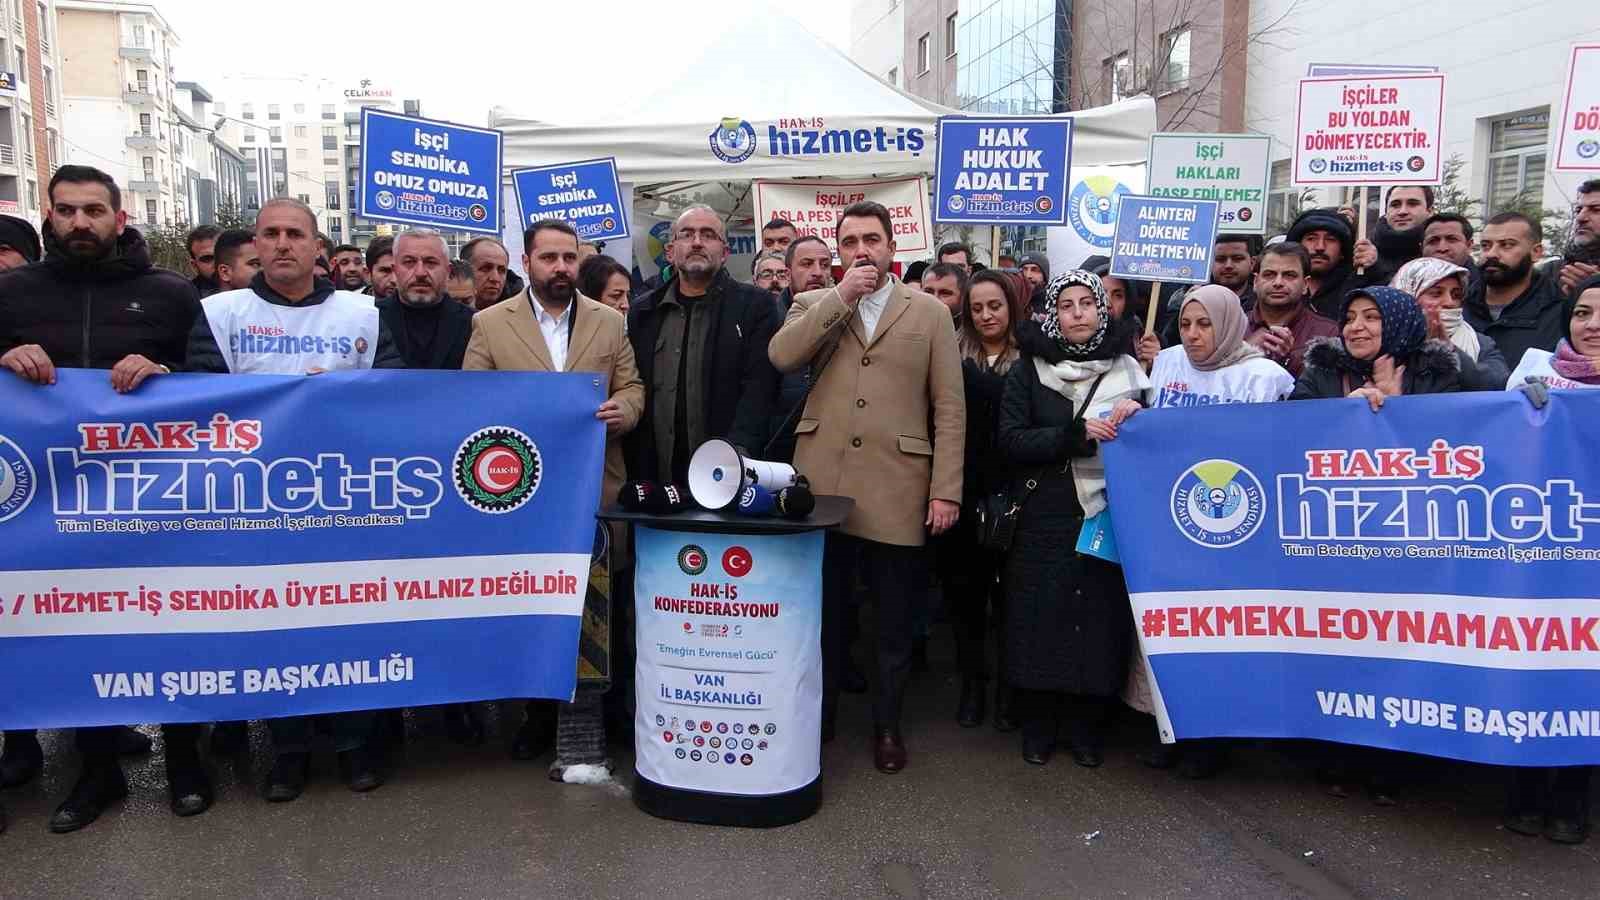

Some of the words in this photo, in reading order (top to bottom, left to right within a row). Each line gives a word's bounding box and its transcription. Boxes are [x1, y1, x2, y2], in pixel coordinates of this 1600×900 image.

[1342, 84, 1398, 109] İŞÇİLER
[1328, 112, 1347, 128] BU
[1352, 110, 1410, 127] YOLDAN
[414, 128, 449, 152] İŞÇİ
[768, 125, 925, 157] hizmet-iş
[979, 128, 1030, 147] HAK
[1305, 128, 1431, 150] DÖNMEYECEKTİR.
[962, 150, 1043, 169] HUKUK
[1196, 142, 1224, 161] İŞÇİ
[391, 150, 471, 176] SENDİKA
[1330, 160, 1404, 174] hizmet-iş
[551, 171, 578, 188] İŞÇİ
[954, 172, 1049, 191] ADALET
[1176, 167, 1240, 180] HAKLARI
[374, 171, 425, 191] OMUZ
[428, 179, 489, 200] OMUZA
[538, 188, 597, 206] SENDİKA
[569, 203, 615, 219] OMUZA
[771, 210, 805, 223] ASLA
[808, 210, 833, 222] PES
[1138, 204, 1198, 222] ALINTERİ
[1139, 222, 1190, 240] DÖKENE
[1118, 242, 1206, 260] ZULMETMEYİN
[240, 328, 353, 359] hizmet-iş
[80, 413, 262, 453] HAK-İŞ
[1306, 438, 1484, 481] HAK-İŞ
[47, 447, 444, 519] hizmet-iş
[57, 519, 90, 532] Tüm
[94, 518, 159, 535] Belediye
[163, 520, 180, 531] ve
[184, 517, 227, 531] Genel
[230, 517, 282, 531] Hizmet
[284, 514, 332, 532] İşçileri
[335, 514, 404, 528] Sendikası
[1282, 544, 1314, 557] Tüm
[1317, 544, 1380, 561] Belediye
[1386, 547, 1402, 557] ve
[1406, 544, 1452, 558] Genel
[1455, 544, 1505, 559] Hizmet
[1508, 544, 1560, 563] İşçileri
[34, 585, 162, 616] HİZMET-İŞ
[169, 584, 279, 612] SENDİKA
[286, 577, 387, 608] ÜYELERİ
[394, 578, 475, 601] YALNIZ
[480, 570, 577, 597] DEĞİLDİR
[690, 583, 738, 601] HAK-İŞ
[655, 596, 779, 618] KONFEDERASYONU
[1142, 605, 1600, 651] #EKMEKLEOYNAMAYAK
[699, 648, 743, 659] Evrensel
[93, 671, 154, 698] VAN
[161, 670, 236, 701] ŞUBE
[243, 653, 414, 696] BAŞKANLIĞI
[695, 674, 725, 687] VAN
[661, 684, 672, 698] İL
[675, 691, 762, 705] BAŞKANLIĞI
[1316, 690, 1376, 720] VAN
[1383, 696, 1457, 730] ŞUBE
